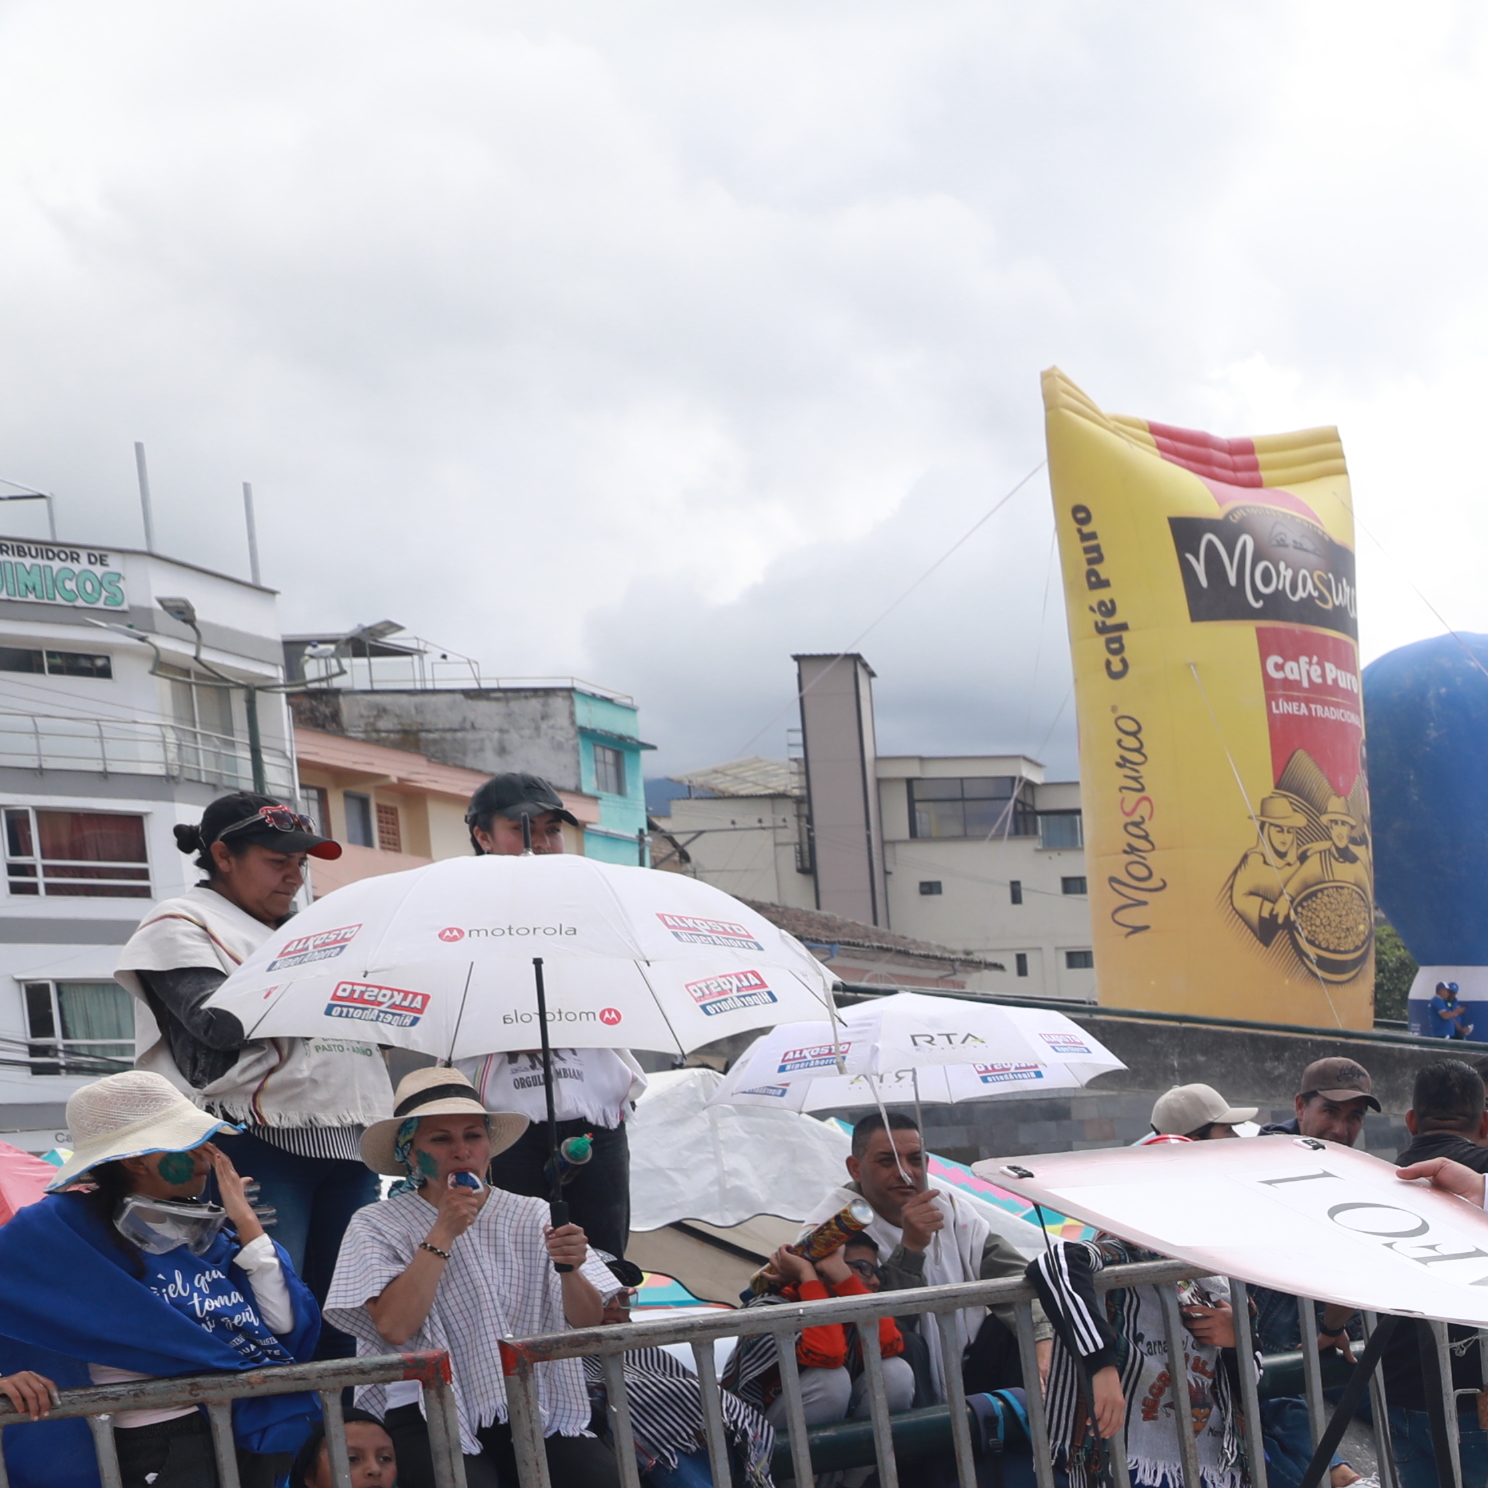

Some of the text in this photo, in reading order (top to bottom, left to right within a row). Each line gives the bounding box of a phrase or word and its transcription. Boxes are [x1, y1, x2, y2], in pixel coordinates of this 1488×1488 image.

[87, 551, 110, 567] DE
[1071, 504, 1130, 680] Café Puro
[1266, 654, 1358, 694] Café Puro
[1271, 698, 1308, 716] LÍNEA
[468, 923, 577, 938] motorola
[663, 915, 749, 935] ALKOSTO
[283, 925, 360, 954] ALKOSTO
[910, 1032, 986, 1047] RTA
[314, 1044, 345, 1054] PASTO
